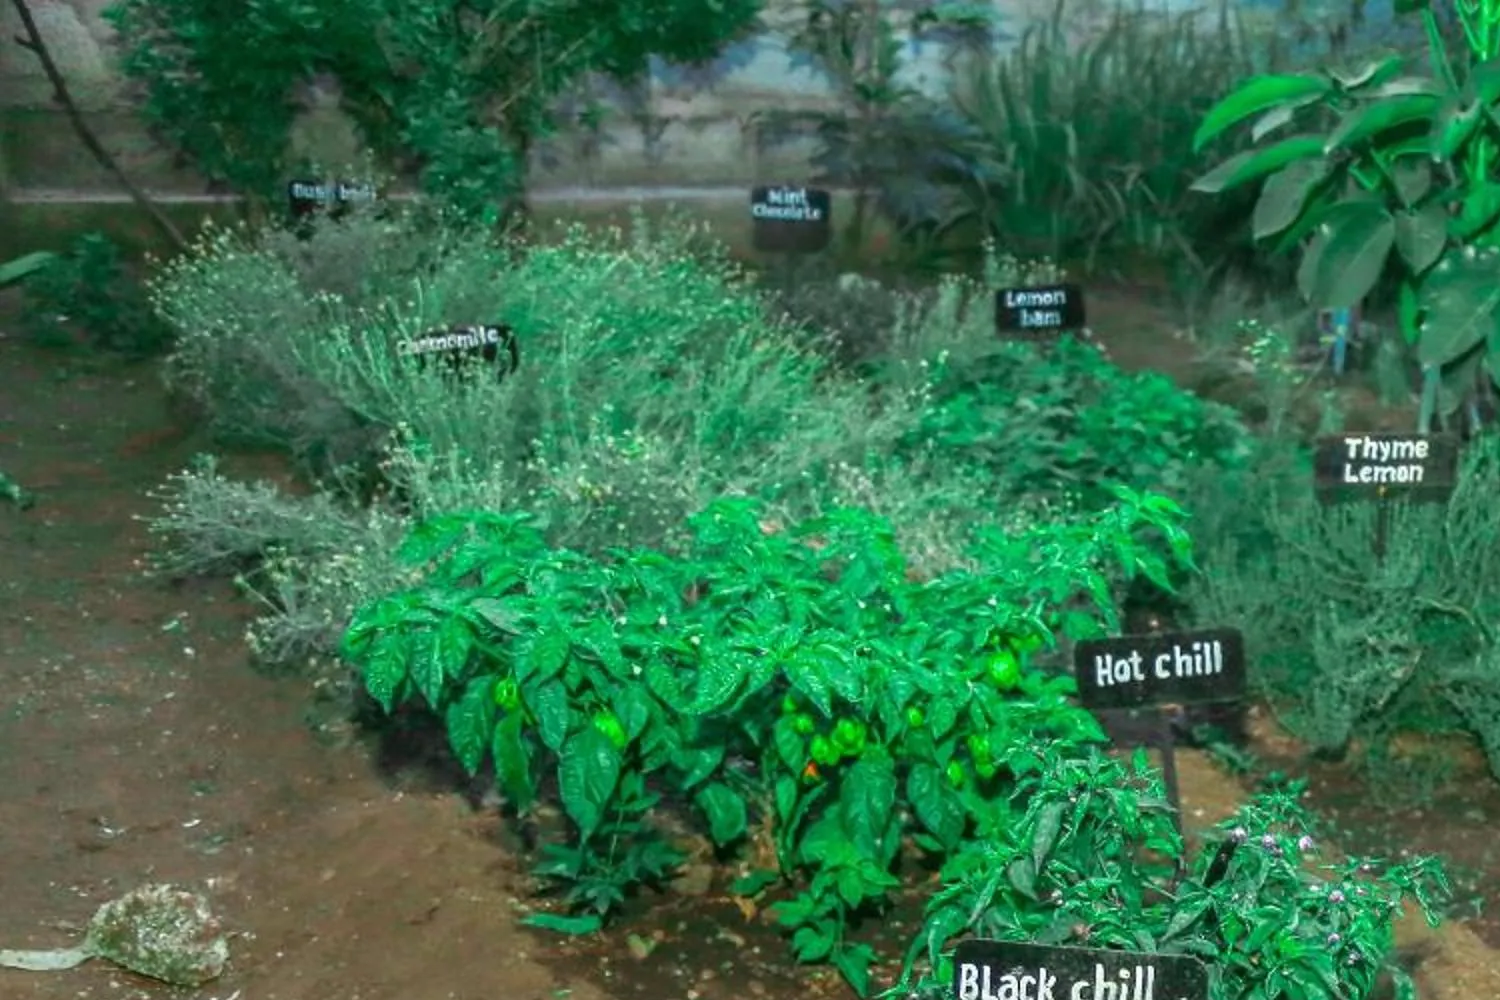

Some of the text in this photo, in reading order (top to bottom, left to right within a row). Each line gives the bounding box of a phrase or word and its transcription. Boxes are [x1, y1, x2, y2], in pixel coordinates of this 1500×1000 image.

[1005, 290, 1066, 308] Lemon
[1344, 435, 1429, 462] Thyme
[1344, 463, 1424, 482] Lemon
[1095, 639, 1223, 687] Hot chill
